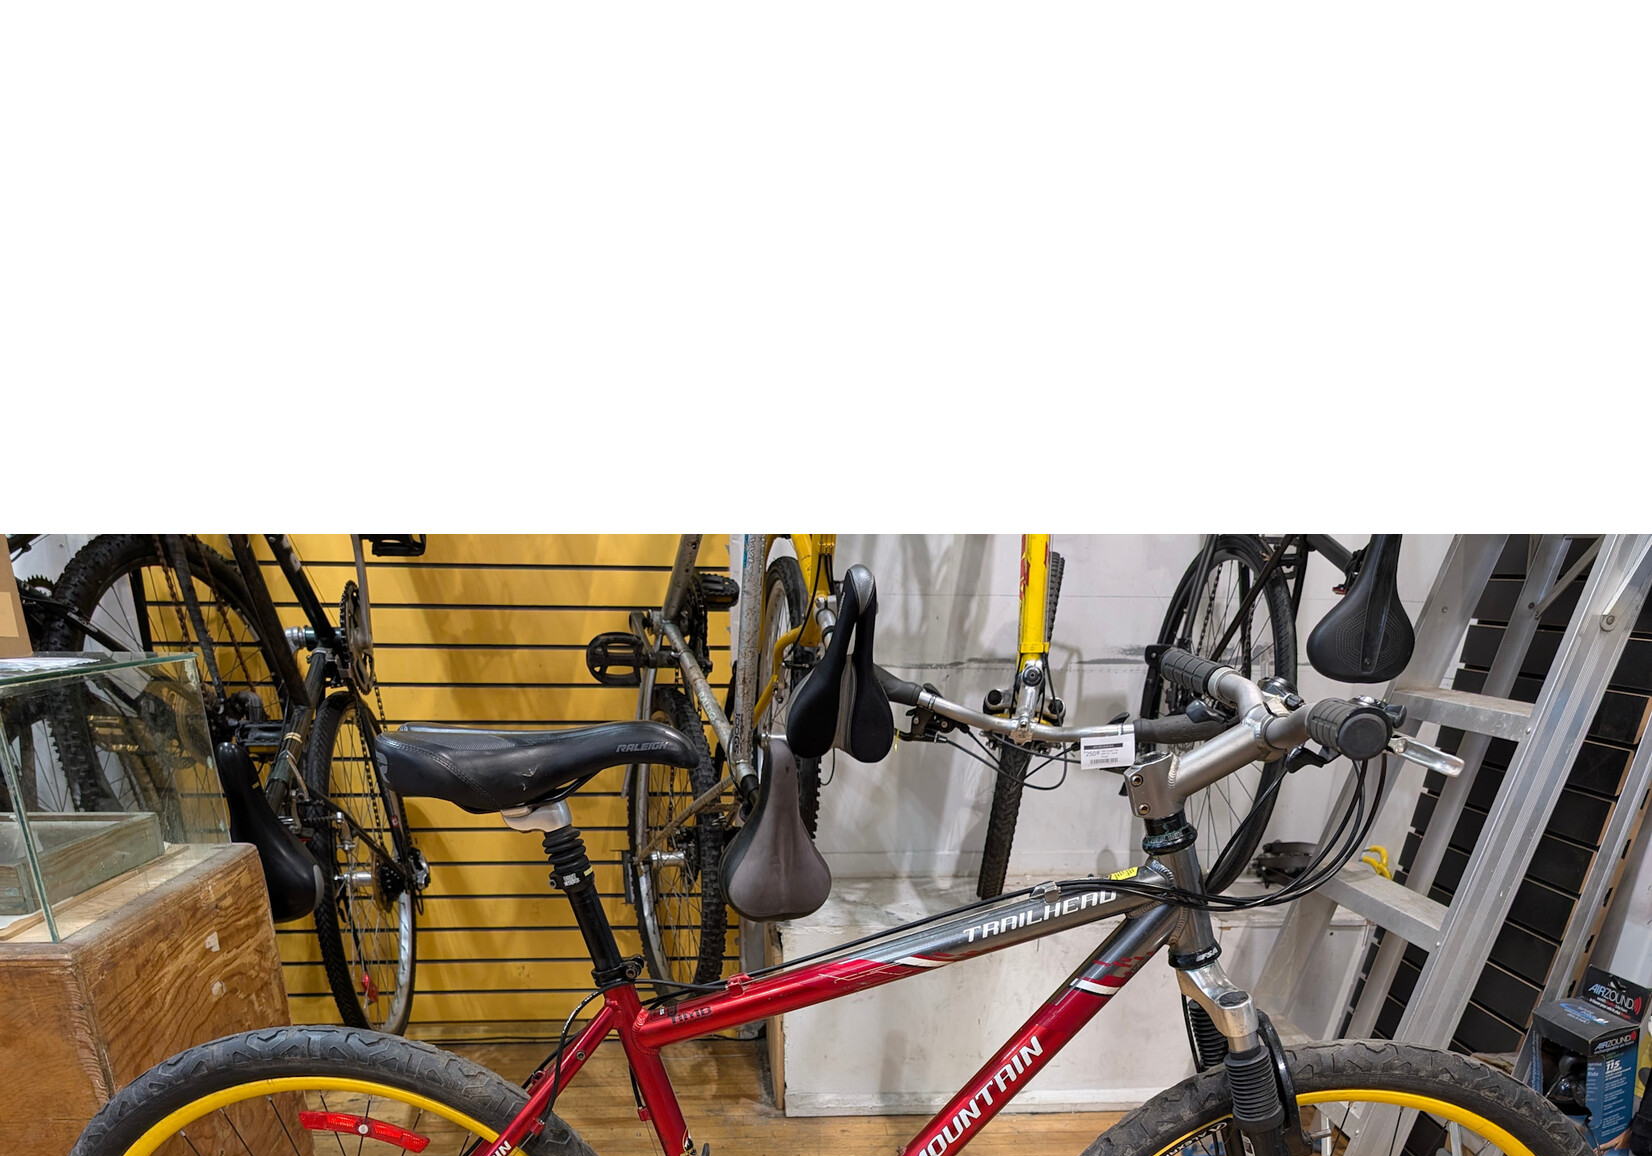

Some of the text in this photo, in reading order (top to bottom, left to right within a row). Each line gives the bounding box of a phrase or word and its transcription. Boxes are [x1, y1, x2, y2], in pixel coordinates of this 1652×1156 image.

[616, 741, 669, 753] RALEIGH
[962, 890, 1117, 943] TRAILHEAD
[1588, 984, 1634, 1011] AIRZOUND
[1594, 1034, 1632, 1051] AIRZOUND
